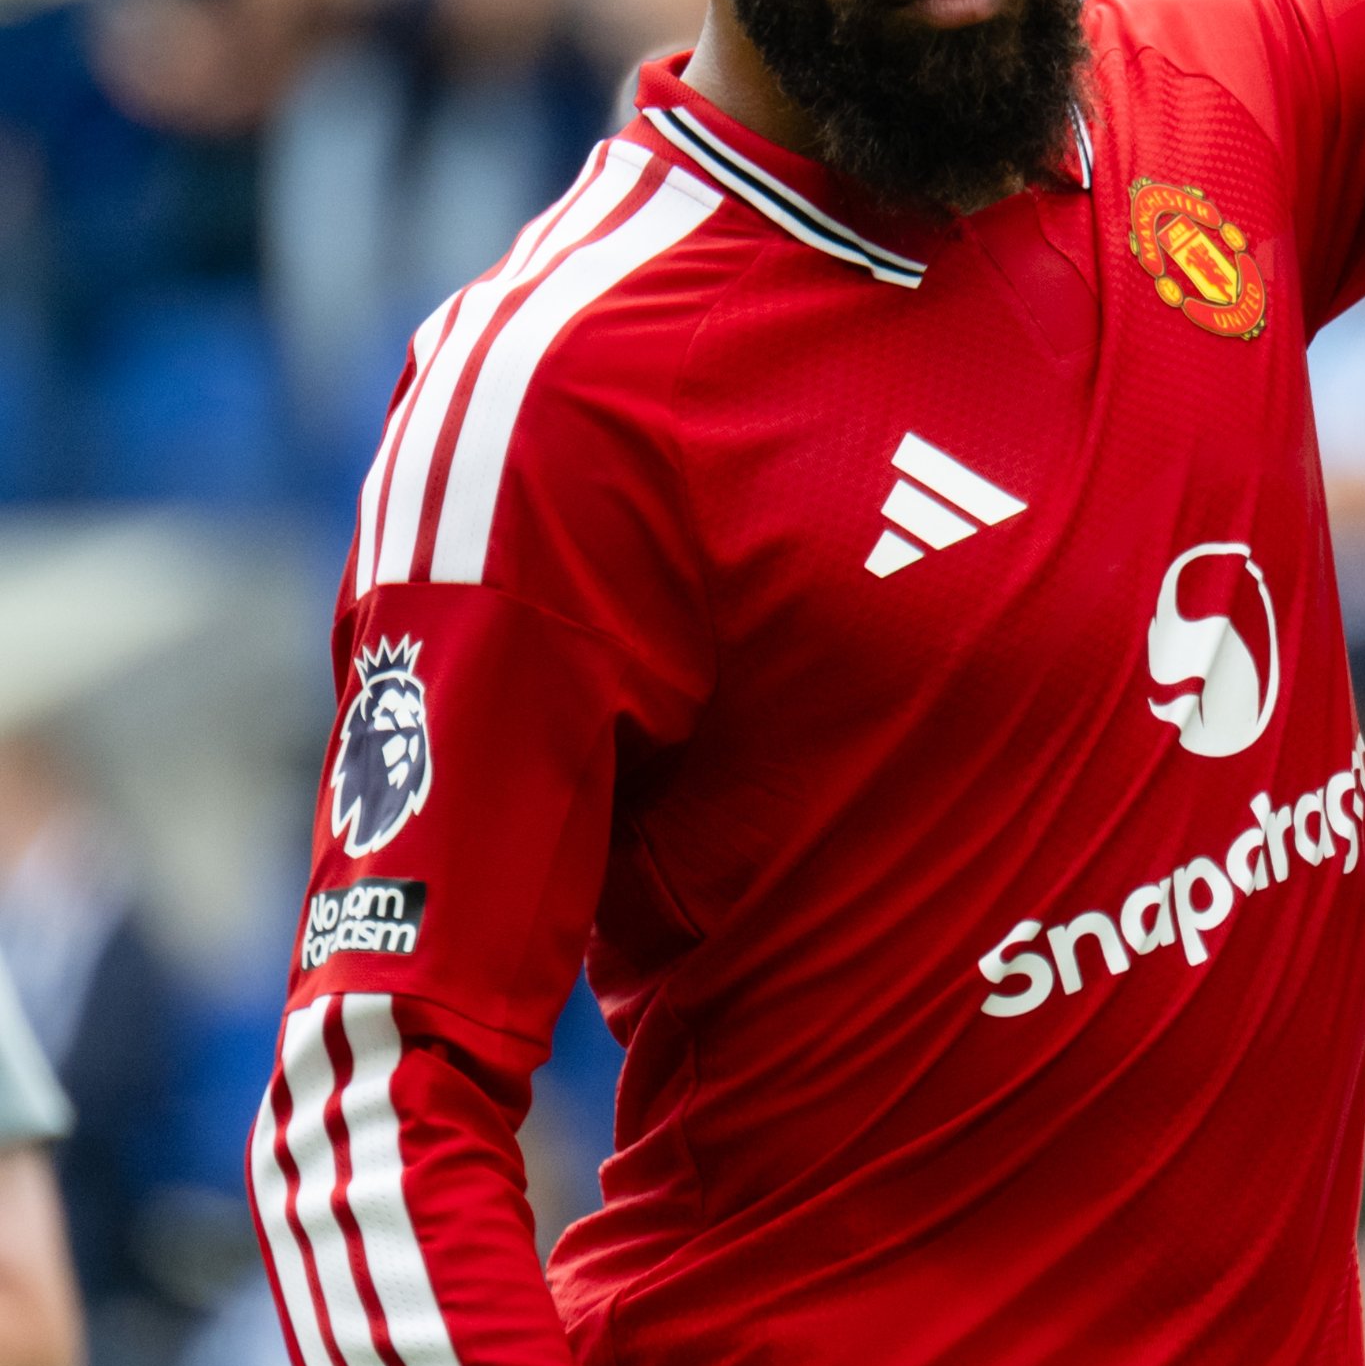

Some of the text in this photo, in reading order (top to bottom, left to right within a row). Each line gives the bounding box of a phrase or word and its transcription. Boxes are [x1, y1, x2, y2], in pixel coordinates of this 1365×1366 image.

[1138, 191, 1210, 261] MANCHESTER
[1213, 282, 1260, 328] UNITED
[306, 893, 339, 933] No
